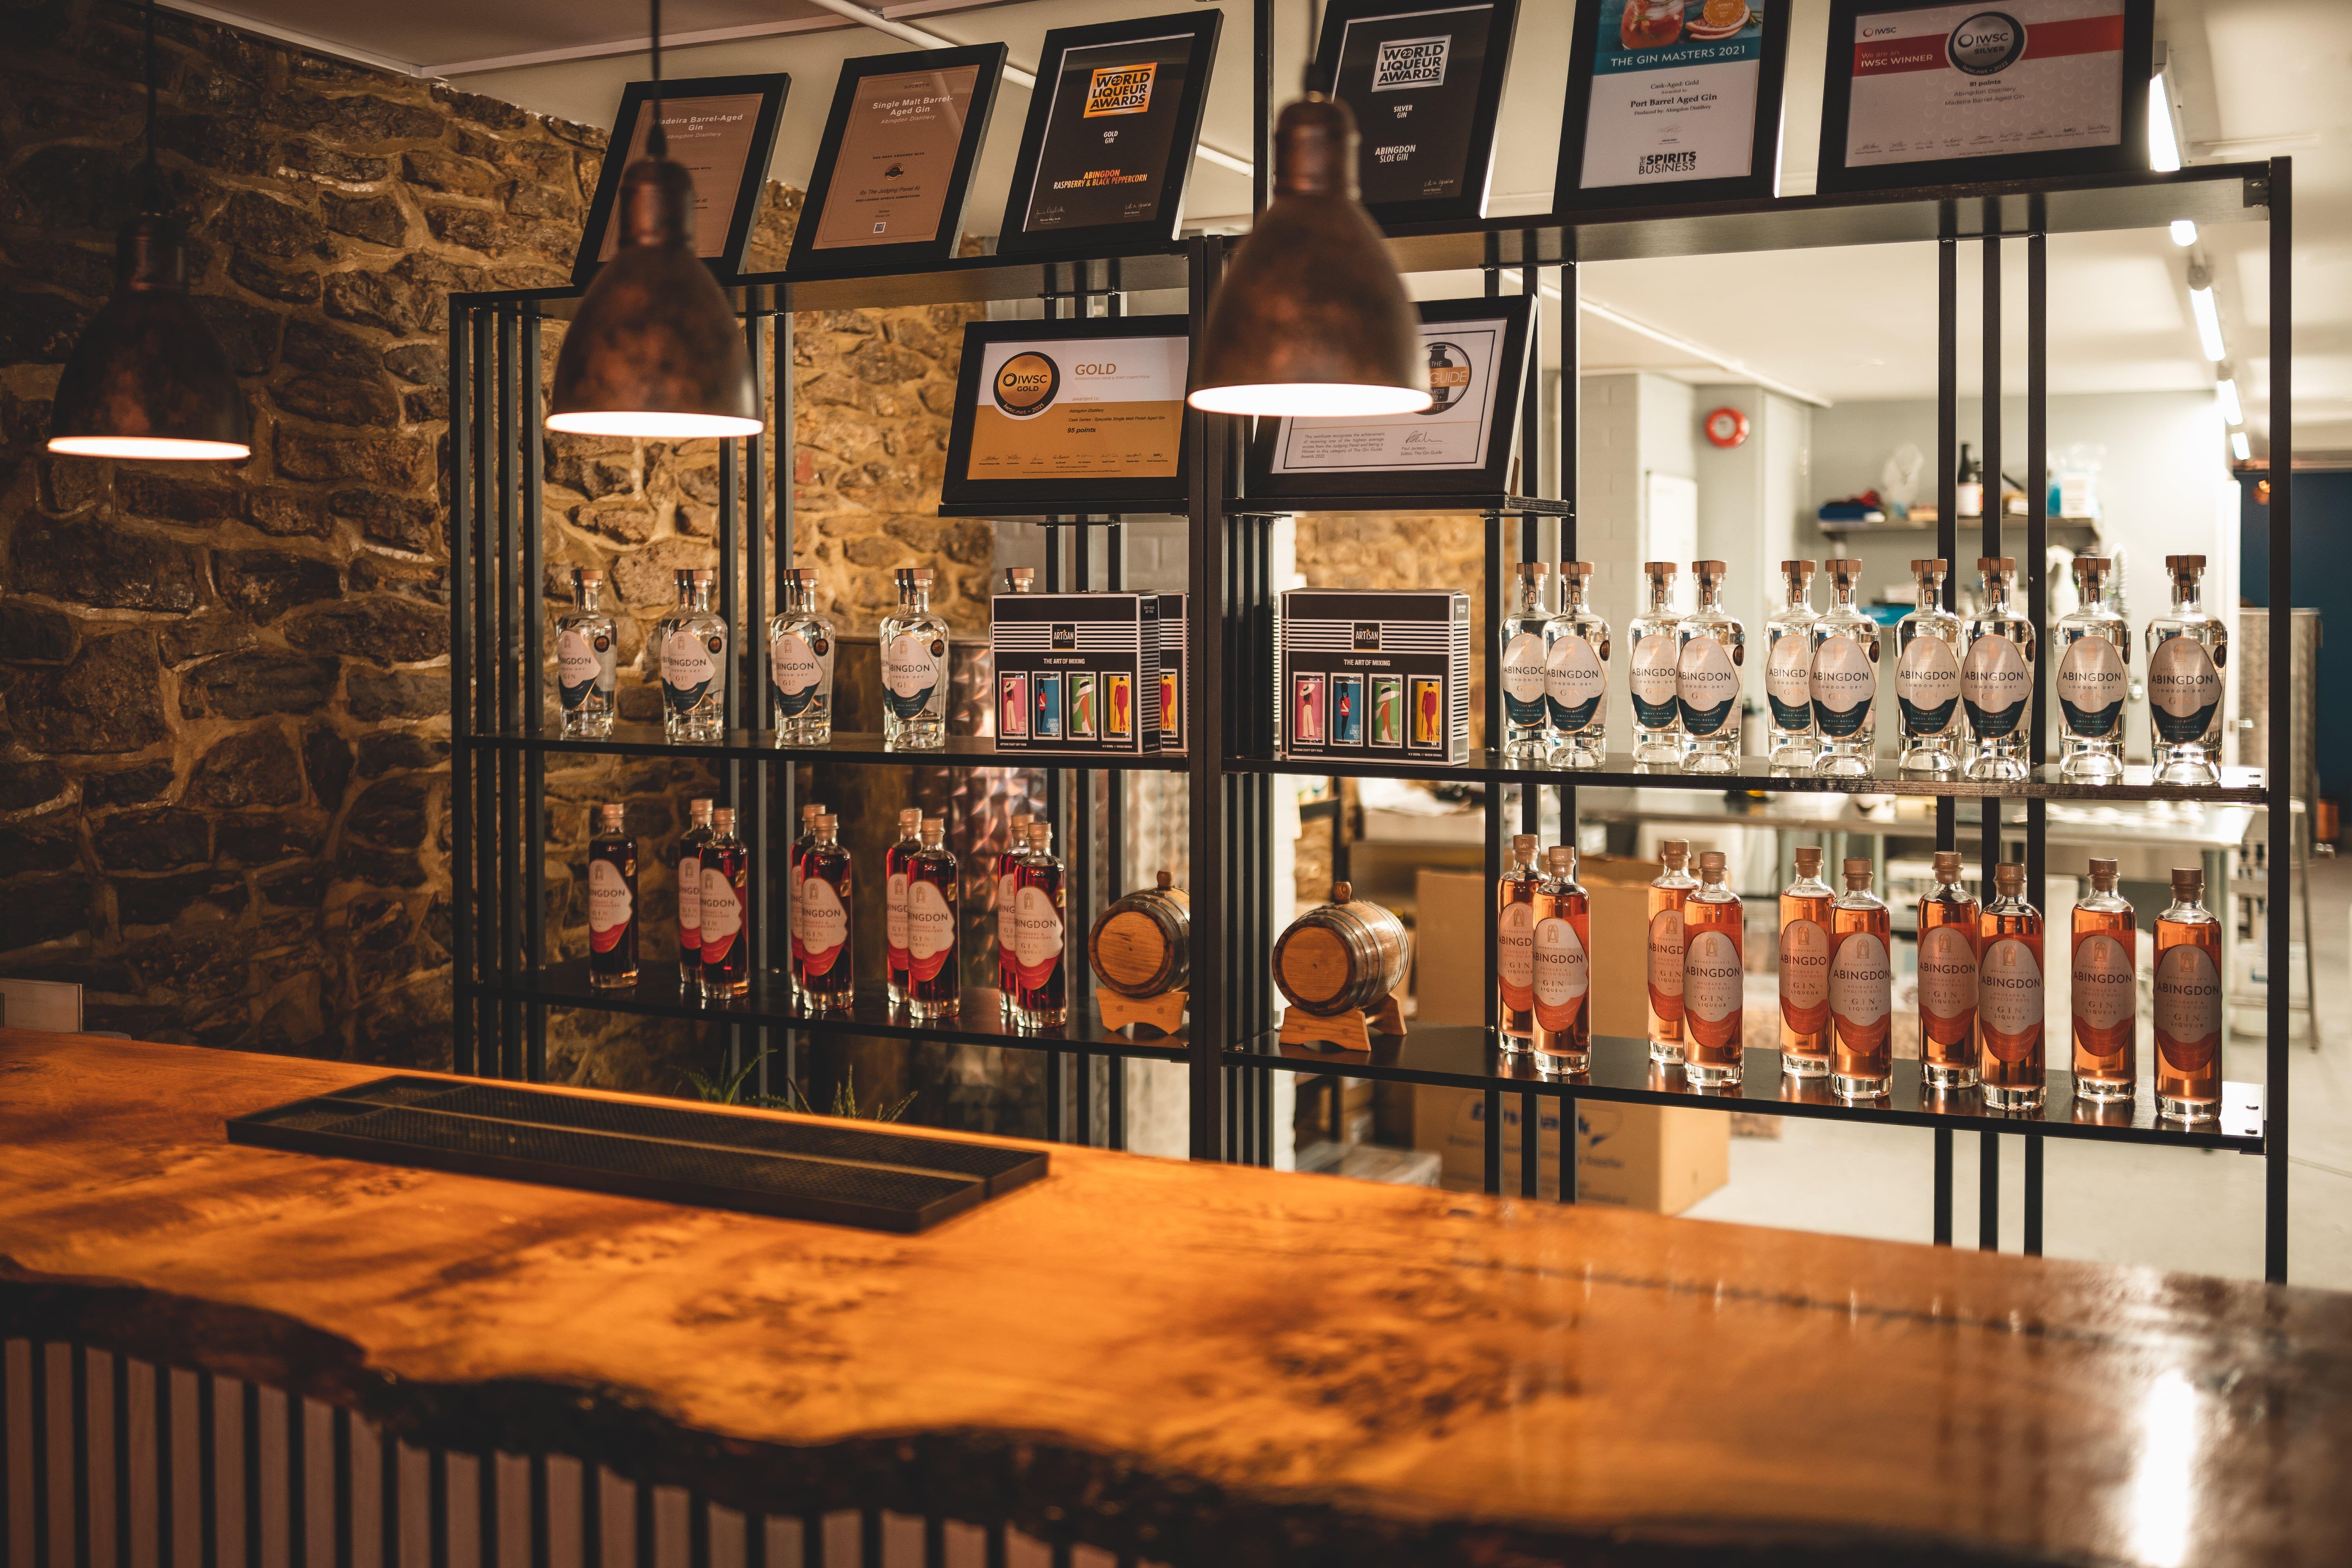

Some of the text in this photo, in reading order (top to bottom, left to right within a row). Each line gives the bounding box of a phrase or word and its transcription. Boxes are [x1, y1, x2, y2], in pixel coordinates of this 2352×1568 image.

[1976, 33, 2008, 44] IWSC
[1611, 45, 1745, 67] THE GIN MASTERS 2021
[1861, 54, 1933, 68] IWSC WINNER
[1380, 56, 1441, 72] LIQUEUR
[1994, 61, 2008, 71] 2022
[1378, 67, 1440, 83] AWARDS
[1650, 81, 1683, 89] Cask-Aged:
[1092, 84, 1147, 98] LIQUEUR
[873, 100, 899, 109] Single
[923, 95, 953, 104] Barrel-
[1090, 94, 1146, 109] AWARDS
[1650, 97, 1674, 106] Barrel
[1677, 94, 1698, 105] Aged
[1973, 95, 2011, 103] Barrel-Aged
[890, 107, 913, 116] Aged
[690, 114, 743, 123] Barrel-Aged
[1375, 144, 1416, 156] ABINGDON
[1379, 153, 1408, 163] SLOE GIN
[1646, 151, 1696, 165] SPIRITS
[1639, 162, 1695, 174] BUSINESS
[1083, 169, 1120, 180] ABINGDON
[1053, 180, 1085, 189] RASPBERRY
[1092, 178, 1110, 186] BLACK
[1111, 174, 1147, 184] PEPPERCORN
[1075, 364, 1116, 375] GOLD
[1018, 375, 1047, 384] IWSC
[1430, 371, 1468, 384] GUIDE
[1004, 403, 1044, 414] iwsc.net 2021
[1546, 669, 1598, 678] ABINGDON
[1678, 671, 1731, 681] ABINGDON
[1813, 672, 1869, 681] ABINGDON
[1900, 671, 1956, 680] ABINGDON
[1965, 671, 2023, 681] ABINGDON
[2062, 672, 2121, 681] ABINGDON
[2152, 675, 2213, 684] ABINGDON
[908, 912, 947, 922] BINGDON
[1015, 919, 1056, 929] BINGDON
[1533, 951, 1583, 964] ABINGDON
[1686, 965, 1740, 978] ABINGDON
[1920, 962, 1975, 974] ABINGDON
[1833, 969, 1889, 980] ABINGDON
[2074, 971, 2132, 984] ABINGDON
[1982, 975, 2040, 988] ABINGDON
[2157, 982, 2219, 996] ABINGDON
